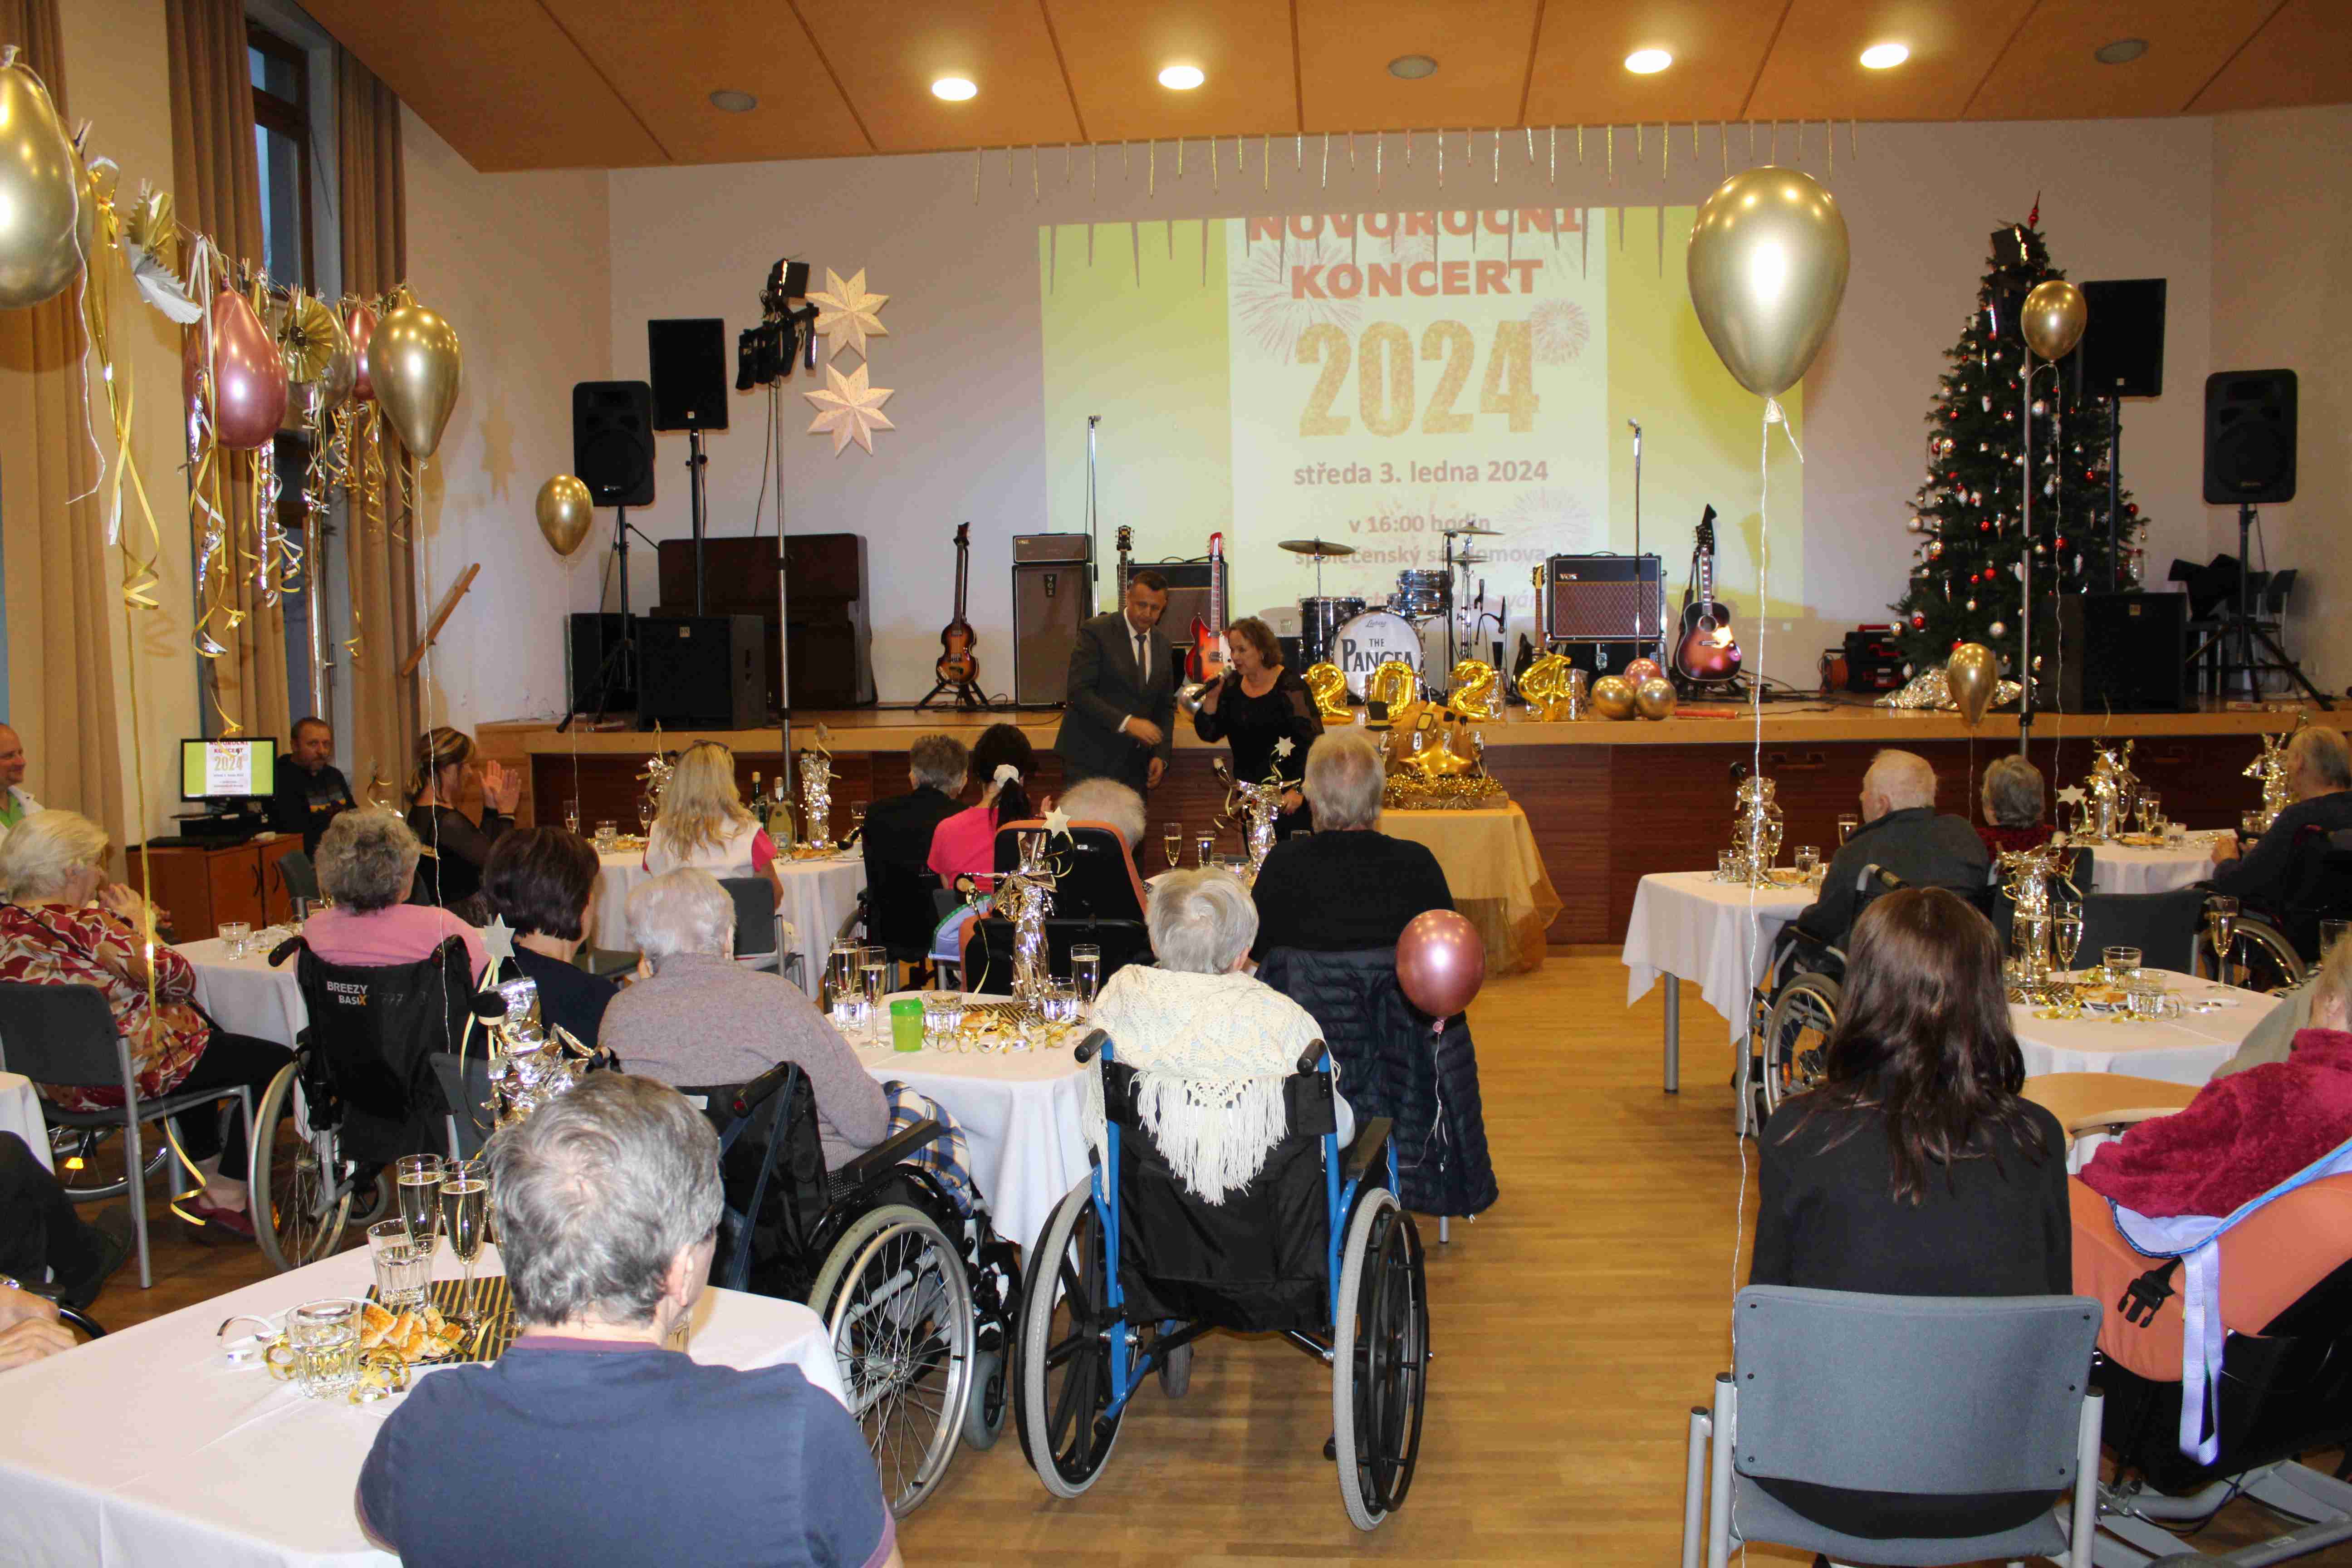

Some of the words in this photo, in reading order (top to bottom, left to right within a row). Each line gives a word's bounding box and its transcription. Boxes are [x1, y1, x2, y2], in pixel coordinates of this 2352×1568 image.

[1291, 259, 1543, 299] KONCERT
[1295, 319, 1540, 437] 2024
[1294, 462, 1372, 485] středa
[1379, 462, 1401, 483] 3.
[1410, 460, 1479, 483] ledna
[1488, 460, 1548, 481] 2024
[1349, 519, 1361, 533] v
[1365, 515, 1425, 533] 16:00
[1430, 514, 1491, 533] hodn
[1368, 638, 1385, 647] THE
[214, 755, 244, 771] 2024
[327, 981, 368, 995] BREEZY
[338, 994, 367, 1006] BASIX
